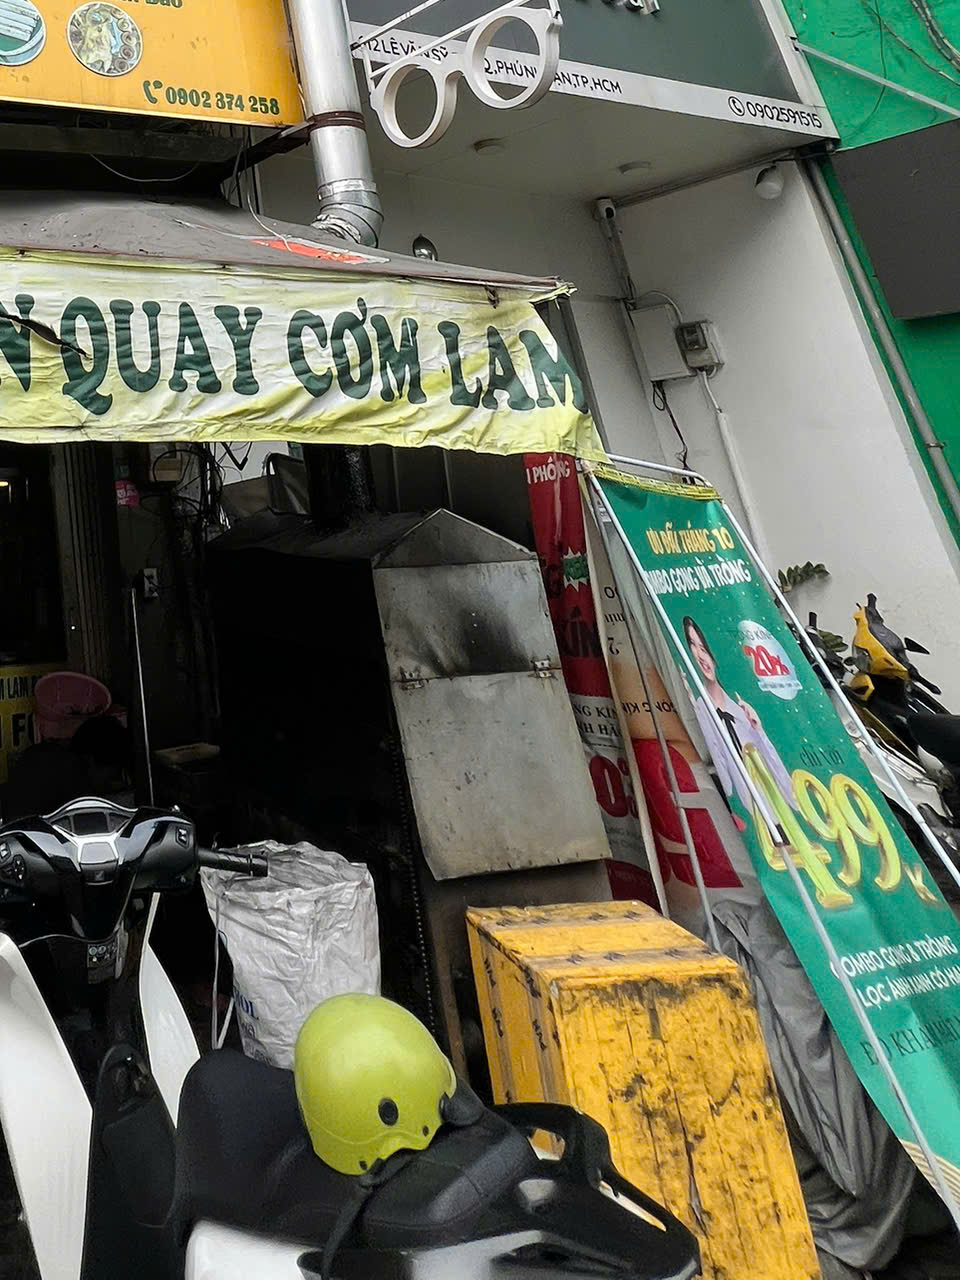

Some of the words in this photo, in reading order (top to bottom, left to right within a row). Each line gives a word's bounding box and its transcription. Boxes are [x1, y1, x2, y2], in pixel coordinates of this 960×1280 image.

[164, 85, 212, 109] 0902
[214, 91, 245, 112] 374
[247, 94, 281, 116] 258
[745, 100, 824, 130] 0902591515
[58, 297, 264, 417] QUAY
[286, 295, 429, 406] CƠM
[437, 318, 592, 415] LAM
[711, 526, 735, 550] 10
[743, 644, 791, 677] 20%
